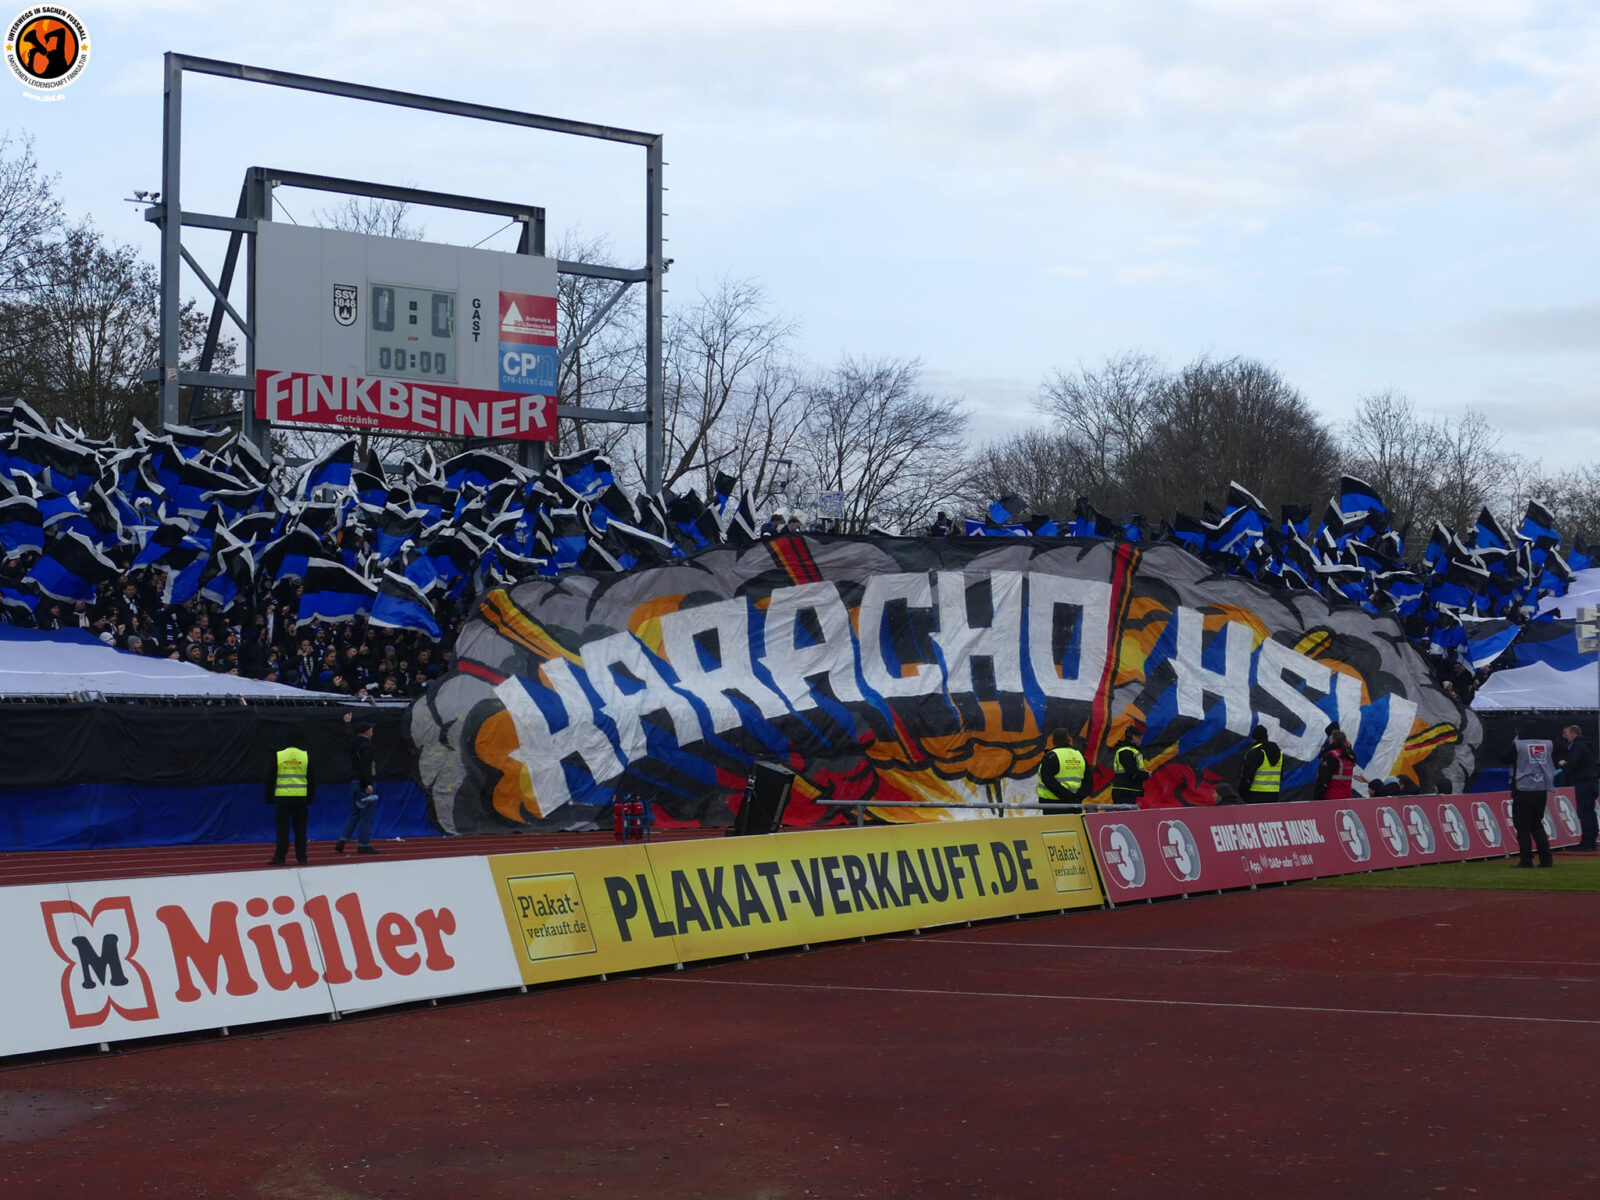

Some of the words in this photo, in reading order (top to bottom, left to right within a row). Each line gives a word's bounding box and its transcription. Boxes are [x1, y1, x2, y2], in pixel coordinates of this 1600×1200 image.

[335, 290, 356, 300] SSV
[335, 298, 356, 308] 1846
[471, 298, 482, 343] GAST
[266, 371, 548, 437] FINKBEINER
[336, 413, 379, 426] Getränke
[1210, 823, 1262, 853] EINFACH
[1258, 821, 1290, 848] GUTE
[1285, 819, 1325, 846] MUSIK.
[1342, 815, 1363, 856] 3
[1383, 812, 1403, 852] 3
[1410, 810, 1429, 849] 3
[1445, 809, 1464, 847] 3
[1478, 806, 1495, 843] 3
[1047, 845, 1081, 862] Plakat-
[1110, 831, 1136, 881] 3
[1168, 827, 1192, 875] 3
[517, 893, 579, 918] Plakat-
[603, 840, 1039, 942] PLAKAT-VERKAUFT.DE
[156, 892, 456, 1003] Müller
[526, 920, 587, 939] verkauft.de
[72, 934, 129, 989] M
